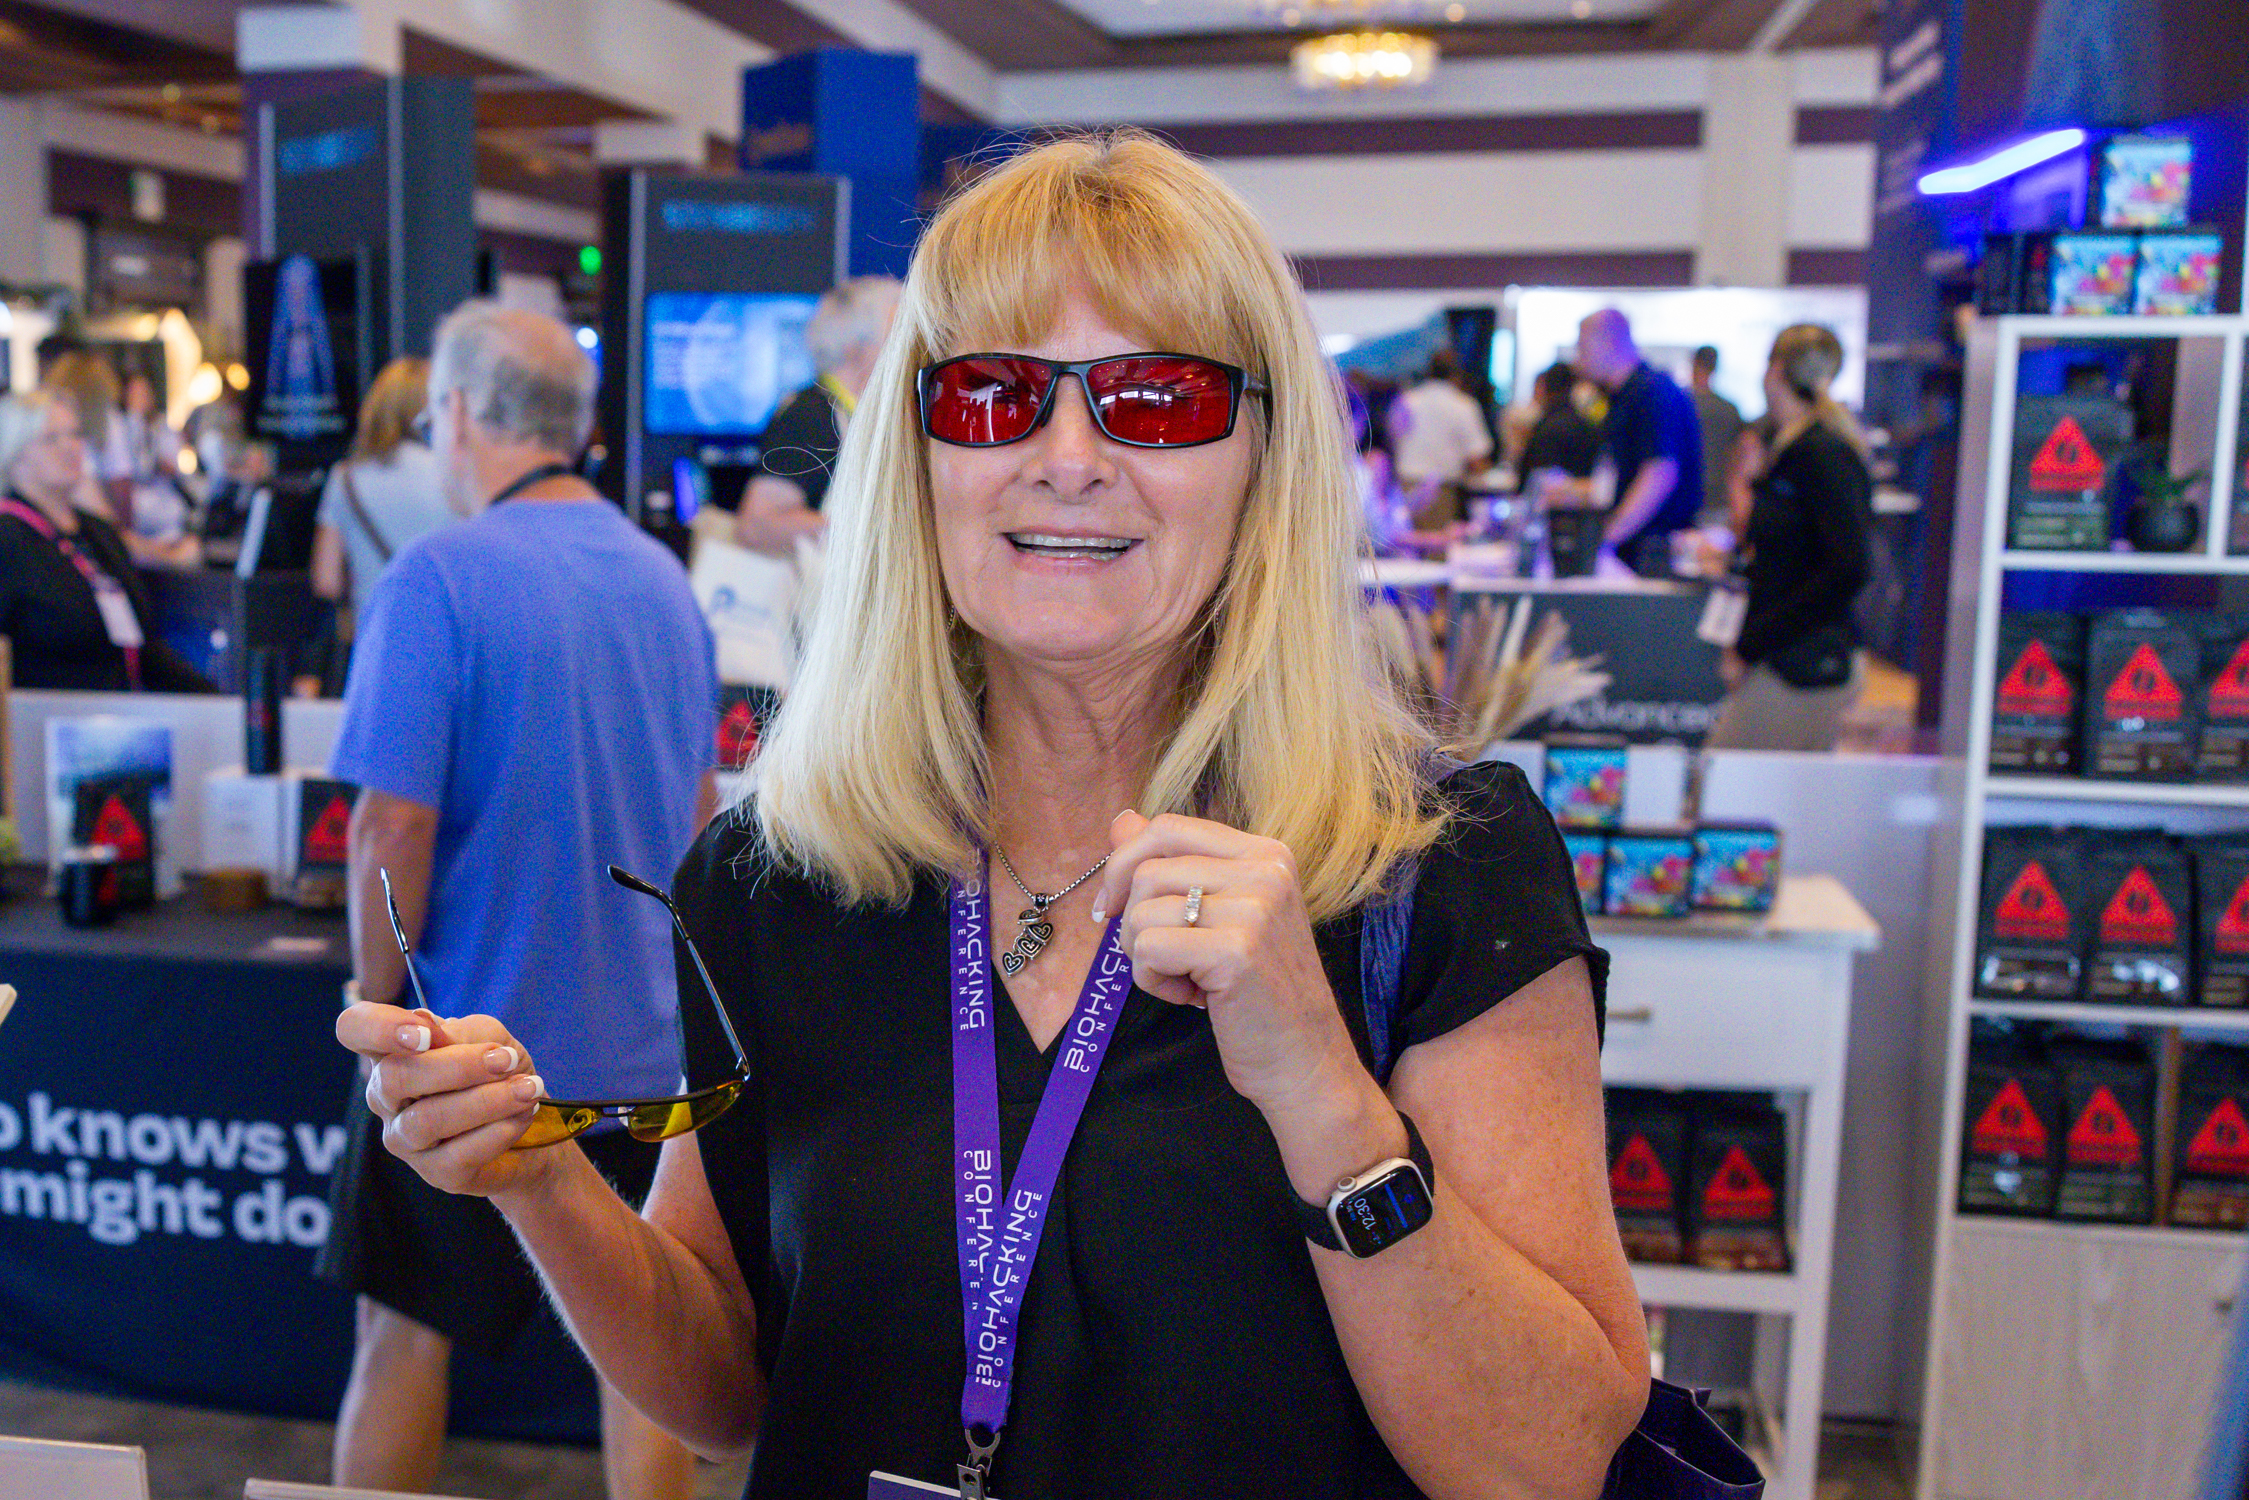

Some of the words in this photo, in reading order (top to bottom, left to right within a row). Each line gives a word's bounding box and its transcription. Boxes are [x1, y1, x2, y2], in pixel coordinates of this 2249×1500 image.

[966, 848, 985, 1029] OHACKING
[1064, 919, 1125, 1071] BIOHACK
[1080, 963, 1130, 1074] CONFER
[28, 1091, 290, 1174] knows
[0, 1159, 224, 1246] might
[232, 1179, 332, 1248] do
[1354, 1197, 1377, 1231] 12:30
[975, 1189, 1033, 1386] BIOHACKING
[991, 1192, 1043, 1388] CONFERENCE
